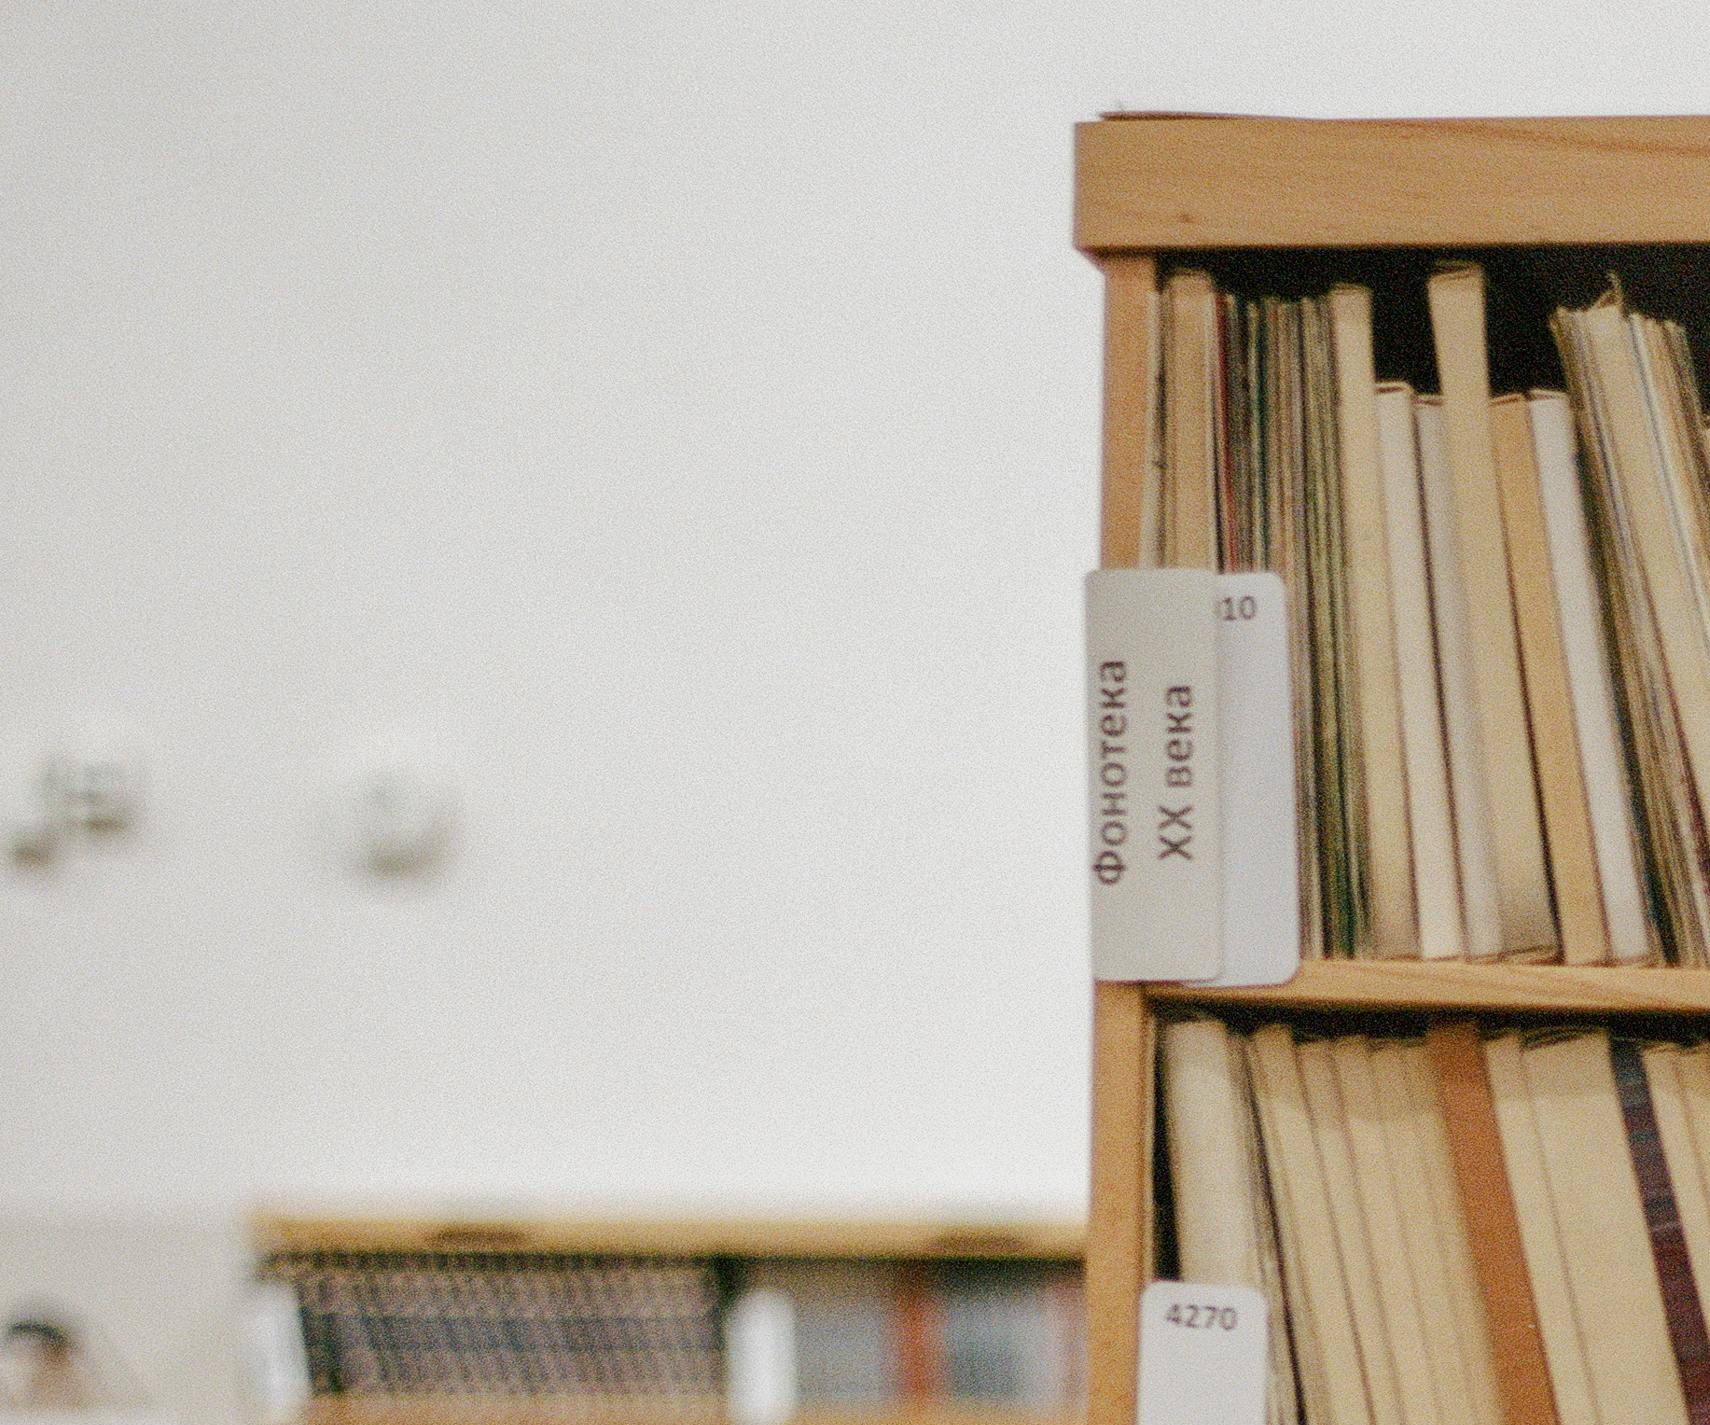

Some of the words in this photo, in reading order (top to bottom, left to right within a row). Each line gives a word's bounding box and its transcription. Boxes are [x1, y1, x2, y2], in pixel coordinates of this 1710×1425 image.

[1093, 661, 1127, 885] Фонотека
[1166, 686, 1193, 788] века
[1166, 1303, 1238, 1331] 4270
